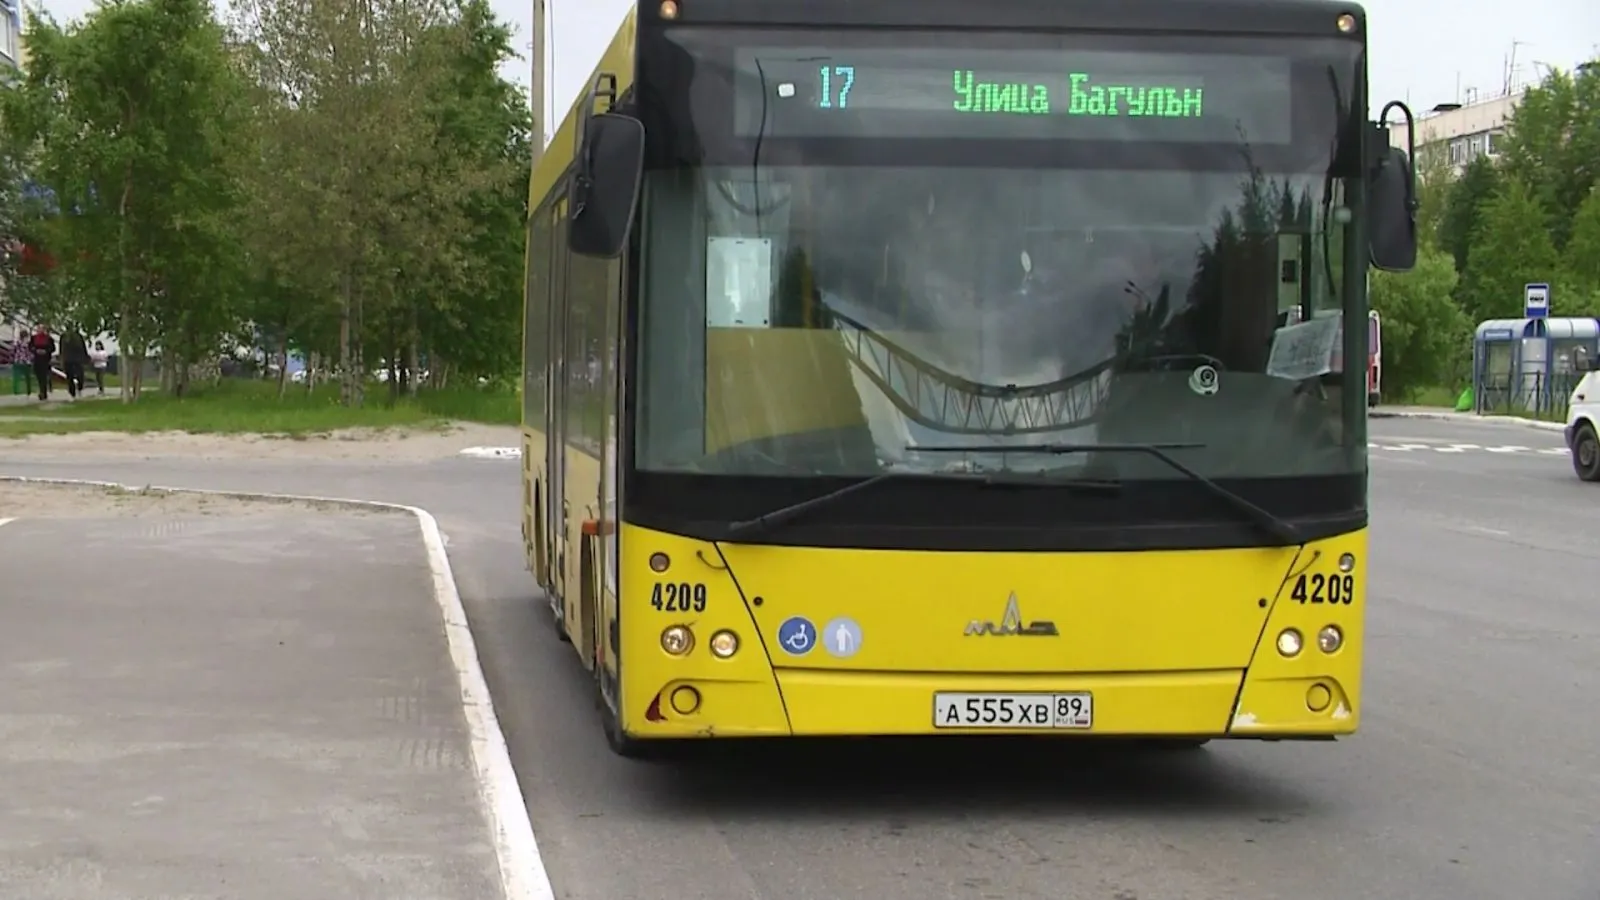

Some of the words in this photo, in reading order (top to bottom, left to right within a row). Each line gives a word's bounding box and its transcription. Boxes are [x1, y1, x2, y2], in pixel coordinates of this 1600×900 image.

[820, 66, 854, 109] 17
[953, 70, 1050, 113] Улица
[1068, 72, 1203, 117] Багульн
[650, 582, 707, 612] 4209
[1290, 572, 1354, 605] 4209
[1055, 717, 1075, 725] RUS
[1057, 697, 1083, 717] 89
